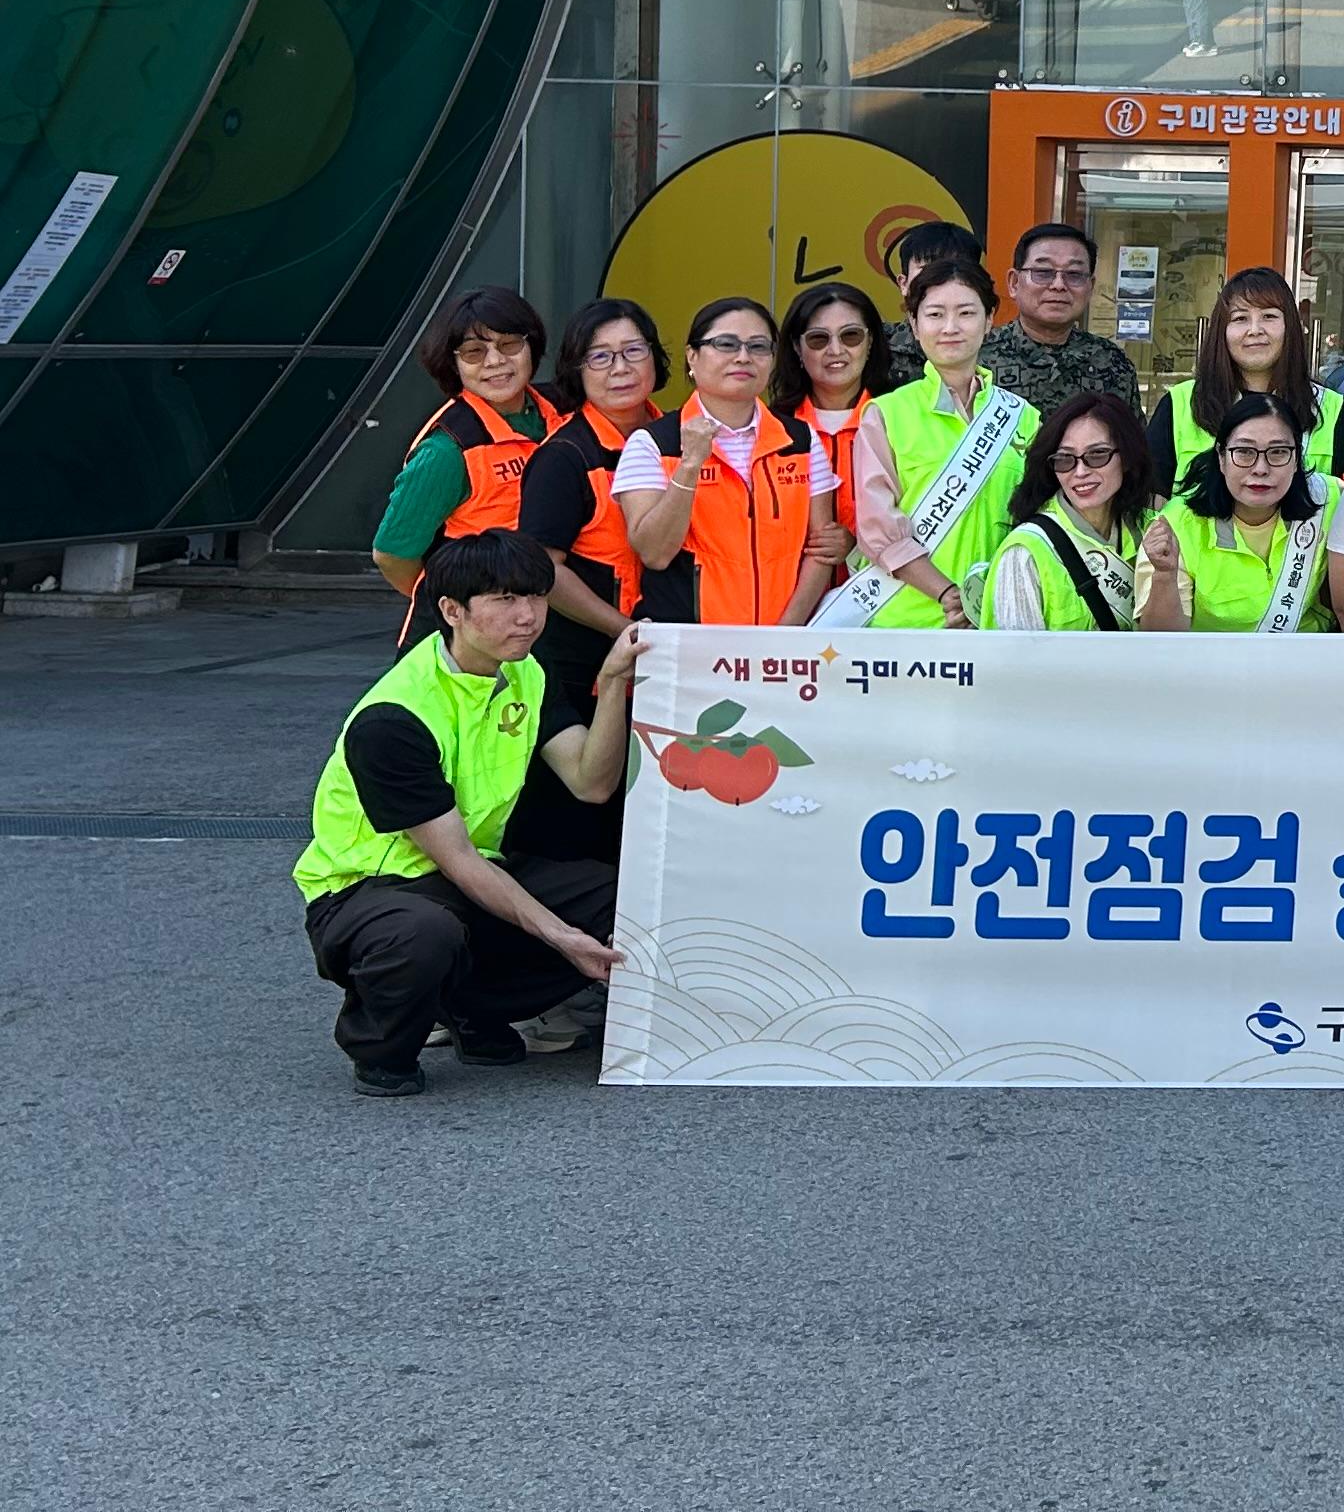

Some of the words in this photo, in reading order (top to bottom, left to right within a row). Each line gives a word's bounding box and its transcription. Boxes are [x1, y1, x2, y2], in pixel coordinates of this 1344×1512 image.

[962, 407, 1011, 478] 대한민국
[700, 467, 717, 482] 미
[910, 475, 969, 547] 안전하
[851, 586, 876, 611] 구미시
[1268, 614, 1290, 633] 안
[859, 807, 1300, 943] 안전점검
